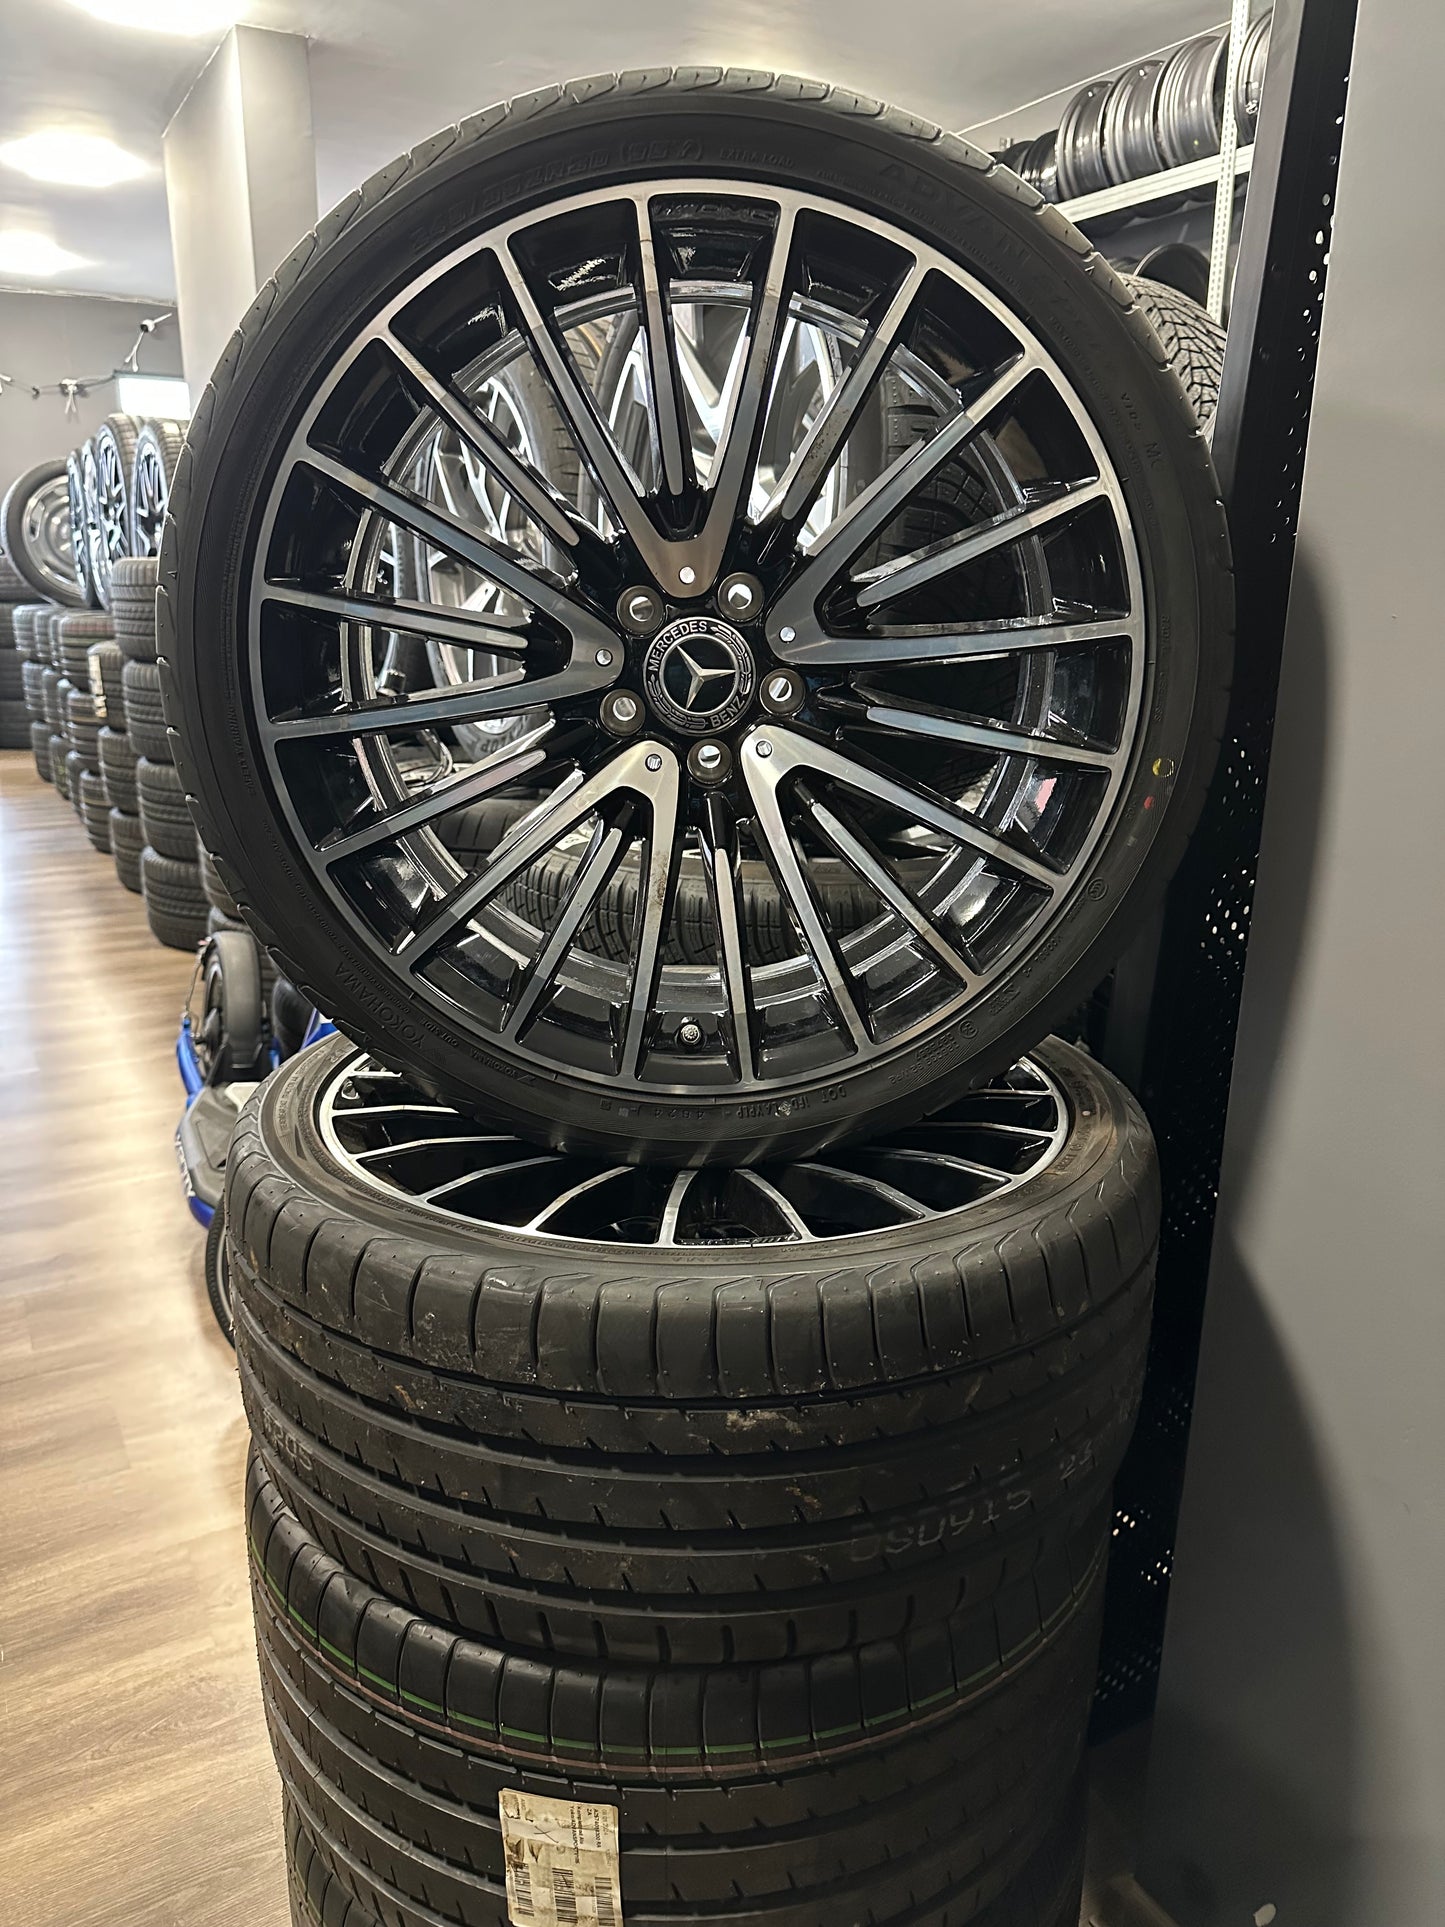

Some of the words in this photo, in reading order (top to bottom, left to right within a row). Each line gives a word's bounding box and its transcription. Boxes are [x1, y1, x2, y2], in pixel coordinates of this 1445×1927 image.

[649, 621, 708, 672] MERCEDES
[710, 695, 746, 728] BENZ
[330, 959, 428, 1052] YOKOHAMA
[466, 1046, 519, 1080] YOKOHAMA
[817, 1082, 848, 1105] DOT
